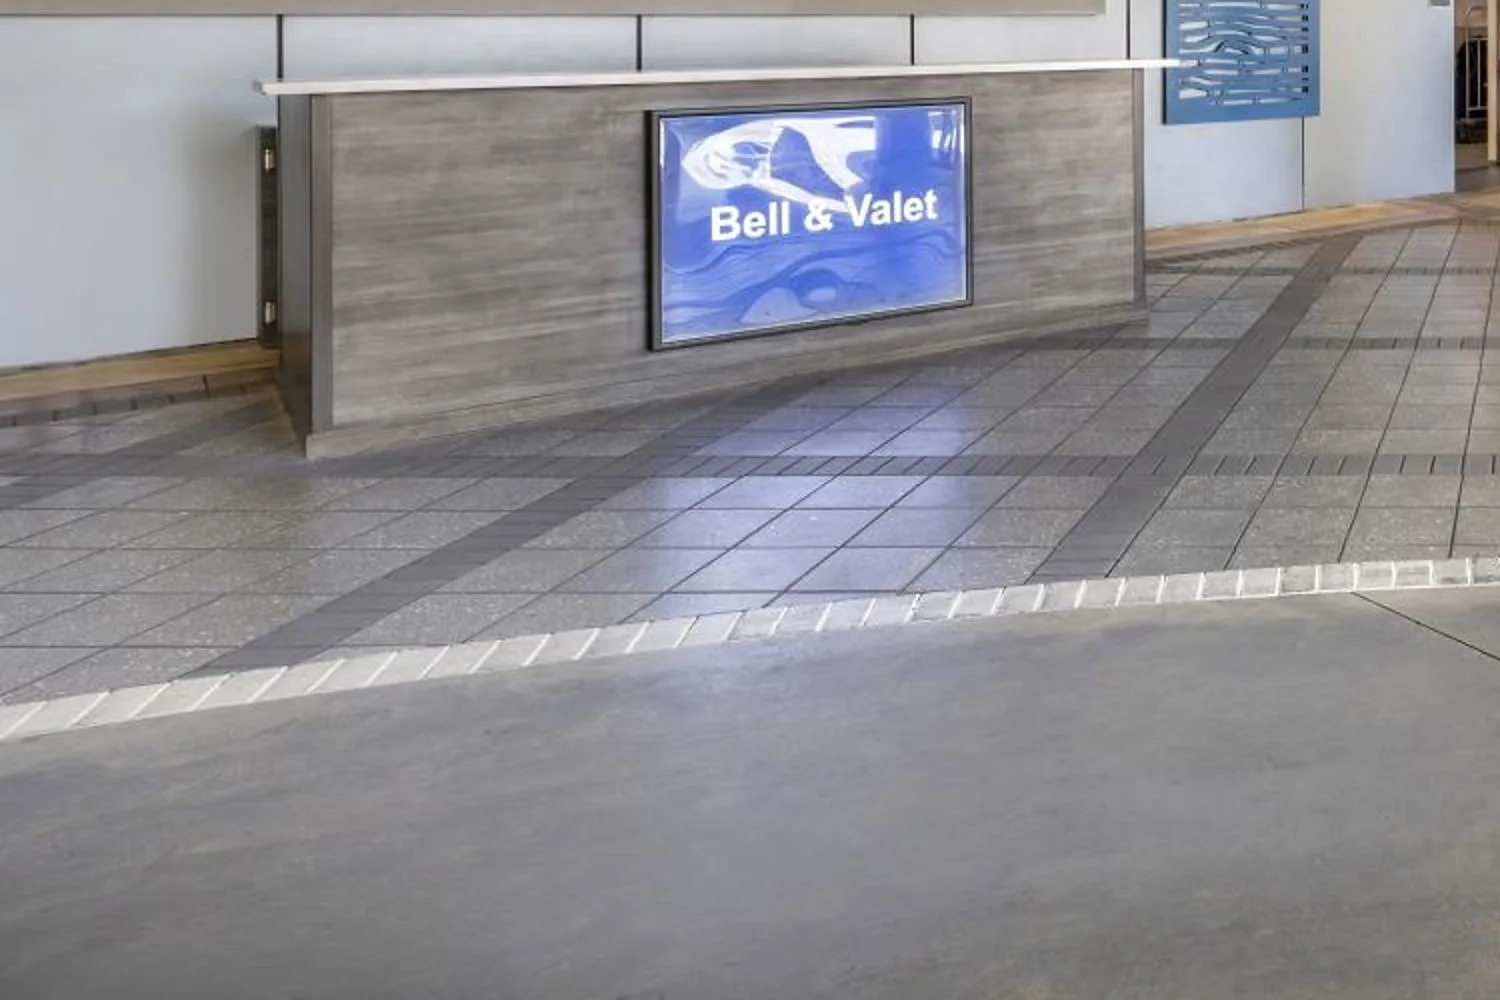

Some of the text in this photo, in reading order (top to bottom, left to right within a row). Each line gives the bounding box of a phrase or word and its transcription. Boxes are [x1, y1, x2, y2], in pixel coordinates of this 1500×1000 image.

[711, 190, 938, 241] Bell & Valet
